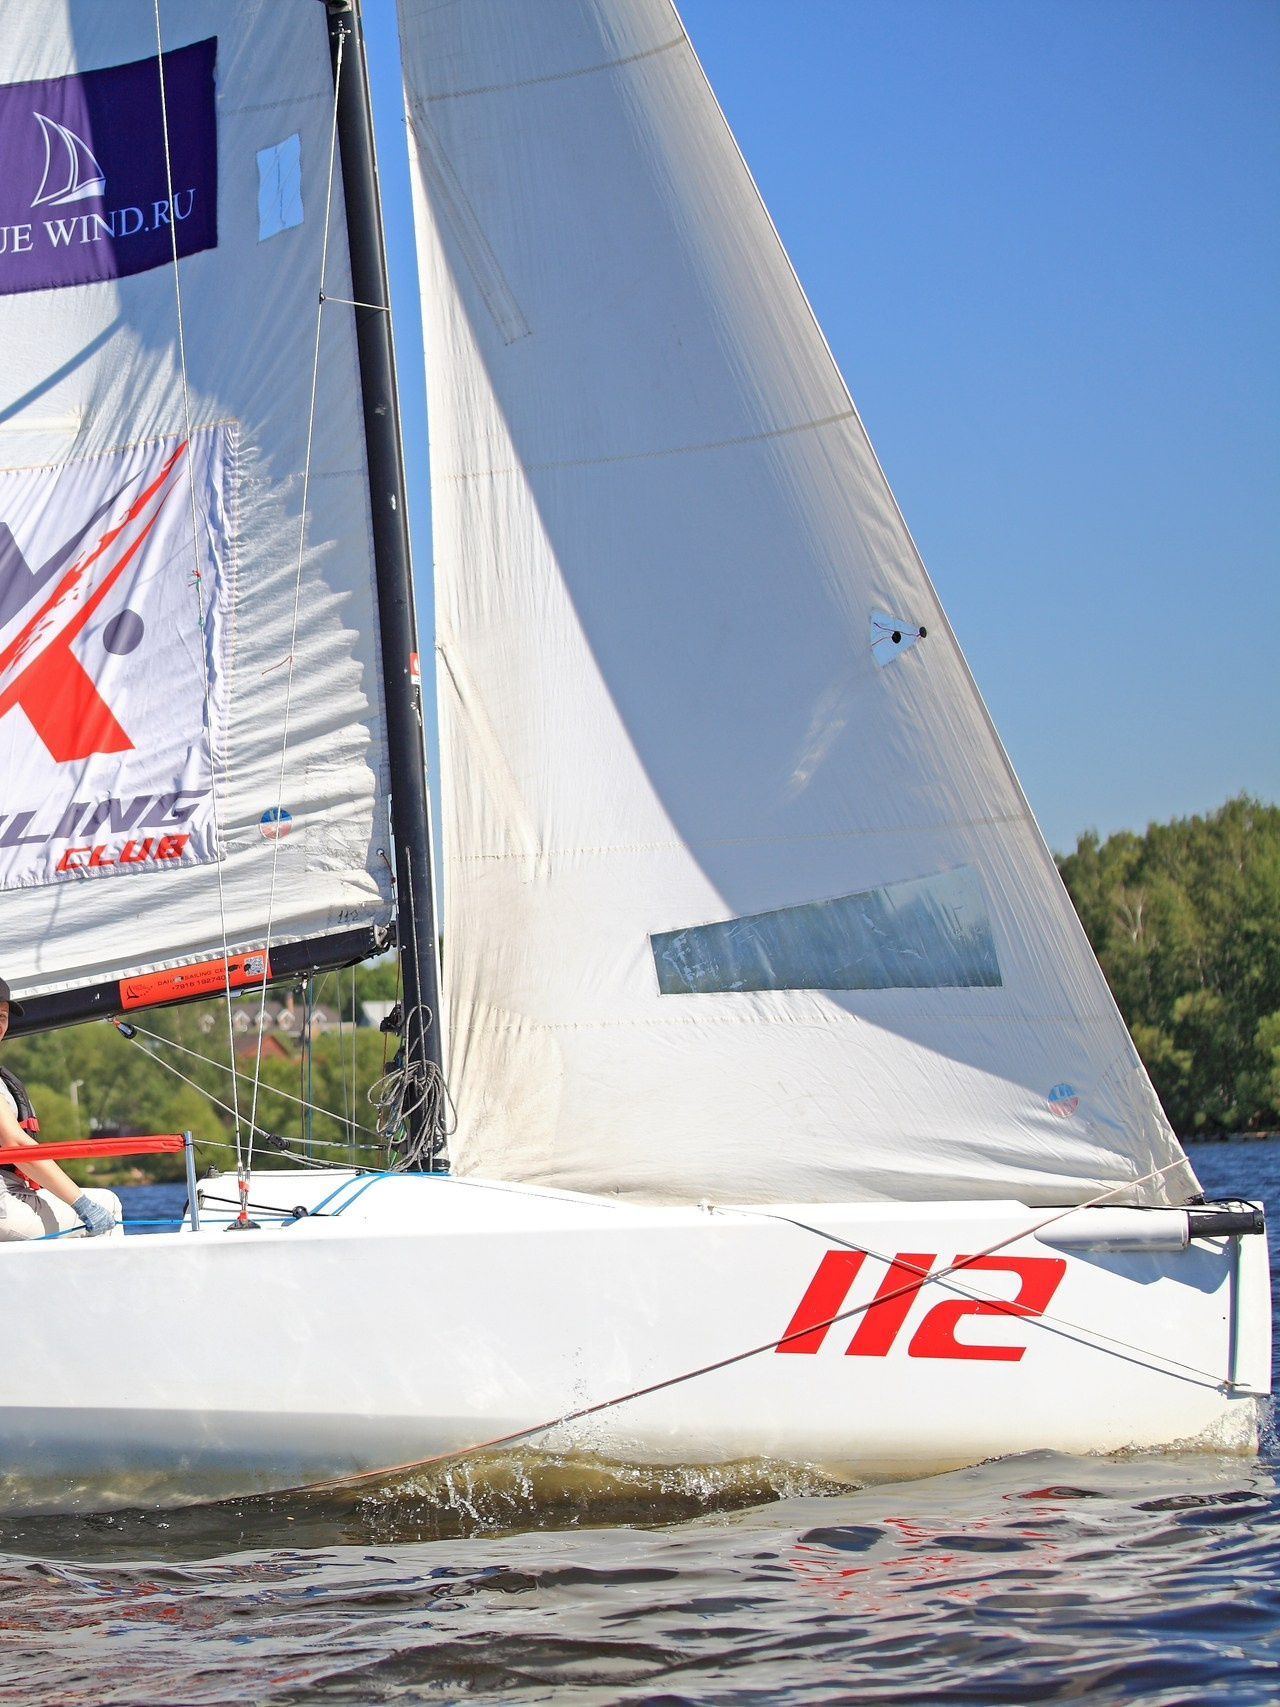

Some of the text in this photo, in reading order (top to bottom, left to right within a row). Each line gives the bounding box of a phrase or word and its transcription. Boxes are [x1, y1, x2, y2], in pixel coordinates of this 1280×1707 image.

[43, 188, 197, 249] WIND.RU
[55, 834, 191, 872] CLUB
[774, 1249, 1067, 1362] 112
